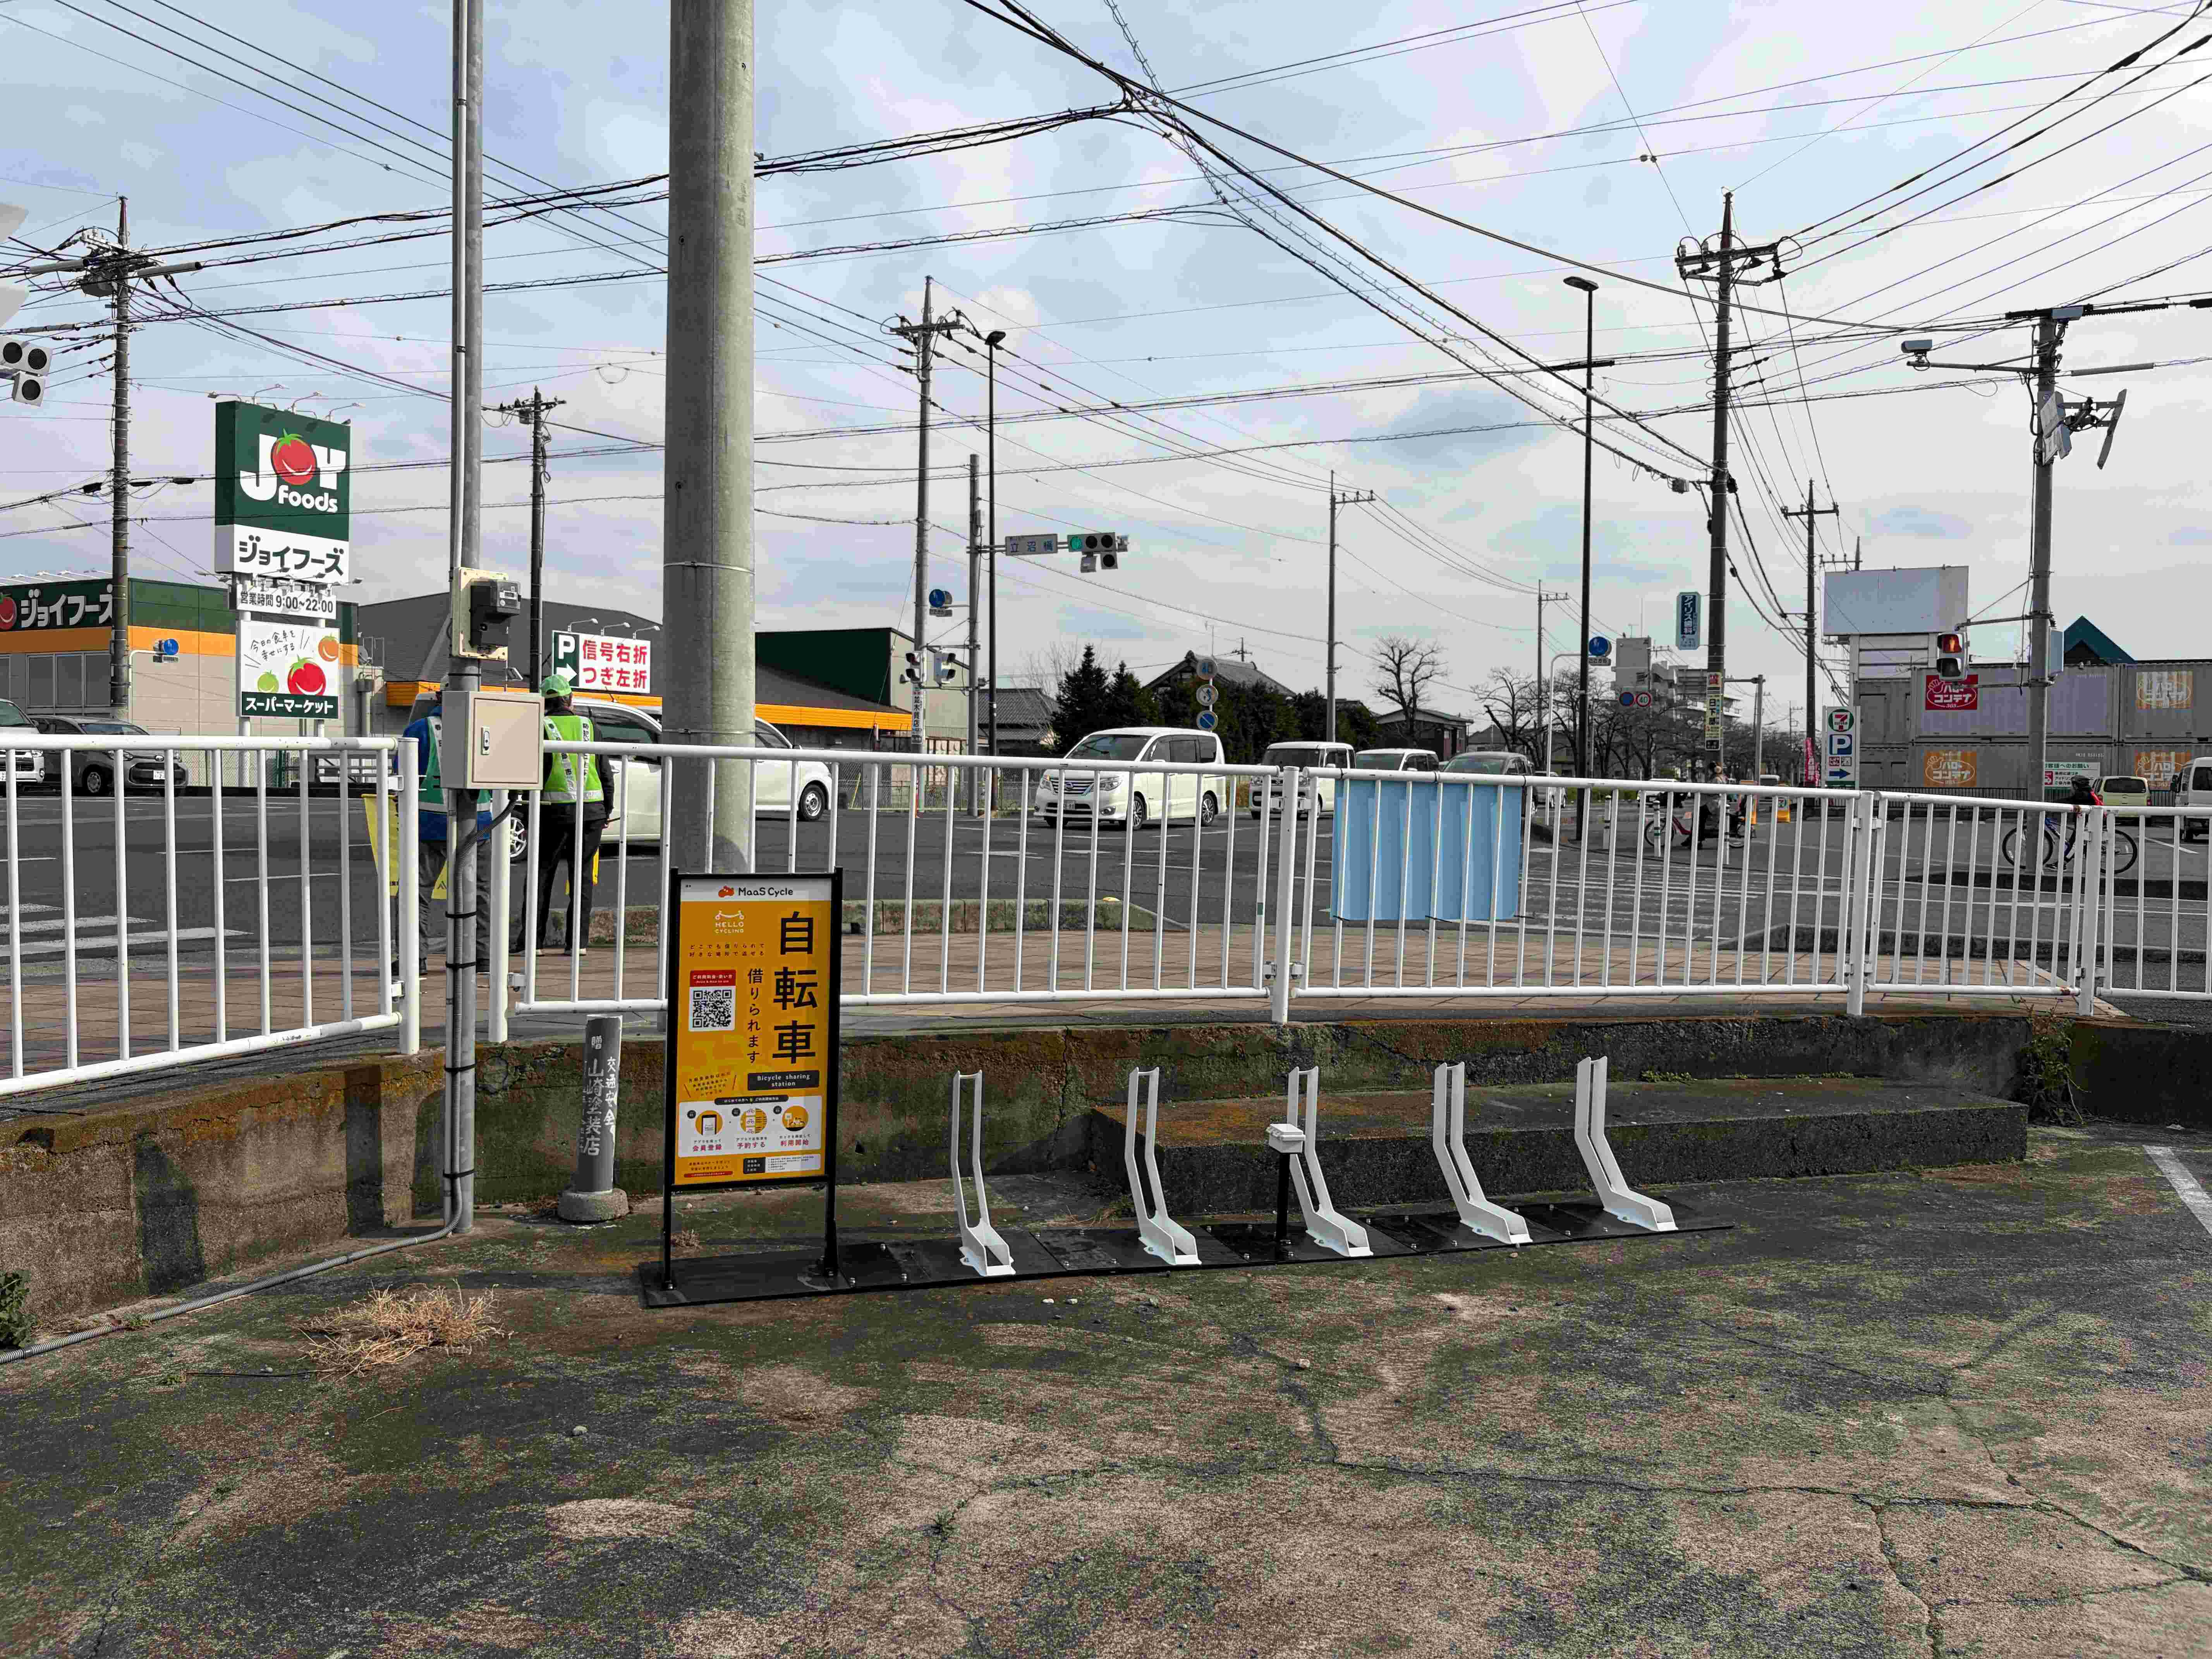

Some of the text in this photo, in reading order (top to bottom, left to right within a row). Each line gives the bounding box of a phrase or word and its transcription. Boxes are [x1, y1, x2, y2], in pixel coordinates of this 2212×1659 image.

[239, 535, 344, 576] ジョイフーズ
[241, 591, 273, 607] 営業時間
[251, 630, 295, 653] 今日の食卓を
[261, 643, 295, 661] 幸せにする
[558, 634, 575, 659] P
[583, 640, 647, 665] 信号右折
[583, 667, 647, 689] つぎ左折
[246, 697, 334, 715] スーパーマーケット
[1934, 694, 1972, 703] コンテナ
[1832, 735, 1851, 754] P
[738, 887, 793, 897] MaaS Cycle
[773, 911, 818, 1064] 自転車
[747, 968, 763, 1064] 借りられます
[603, 1056, 617, 1126] 交通安全
[582, 1058, 604, 1156] 山崎塗装店
